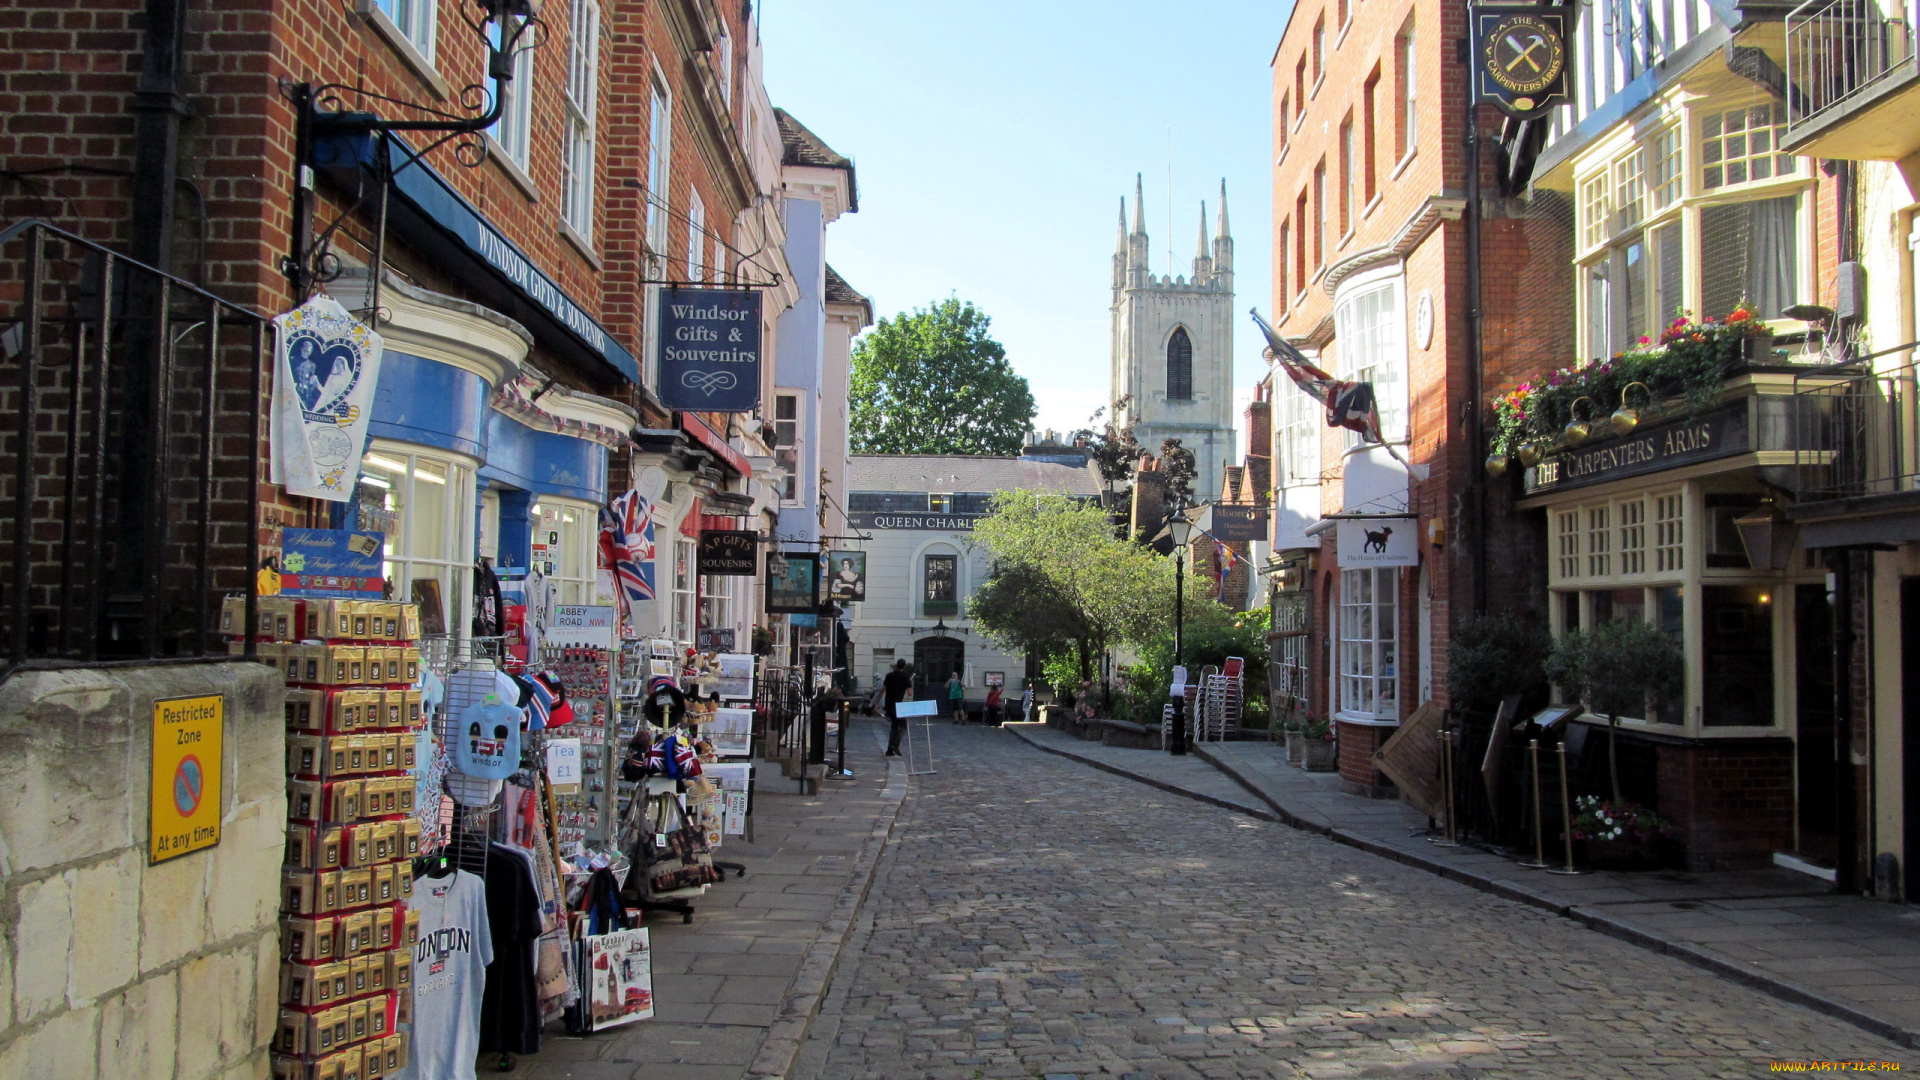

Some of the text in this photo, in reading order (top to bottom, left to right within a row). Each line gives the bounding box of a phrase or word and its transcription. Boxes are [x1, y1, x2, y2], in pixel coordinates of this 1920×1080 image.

[1511, 17, 1532, 25] THE
[1487, 59, 1560, 92] CARPENTERS ARMS
[478, 221, 605, 353] WINDSOR GIFTS & SOUVENIRS
[671, 304, 749, 321] Windsor
[675, 326, 742, 342] Gifts &
[665, 345, 756, 362] Souvenirs
[304, 413, 334, 424] WEDDING
[1537, 423, 1710, 485] THE CARPENTERS ARMS
[874, 516, 922, 529] QUEEN
[705, 535, 752, 553] A P GIFTS
[725, 549, 732, 557] &
[702, 559, 753, 568] SOUVENIRS
[560, 608, 587, 616] ABBEY
[560, 618, 582, 626] ROAD
[163, 704, 215, 725] Restricted
[177, 729, 202, 745] Zone
[553, 745, 575, 757] Tea
[472, 756, 502, 767] Windsor
[556, 766, 571, 778] £1
[157, 825, 215, 853] At any time
